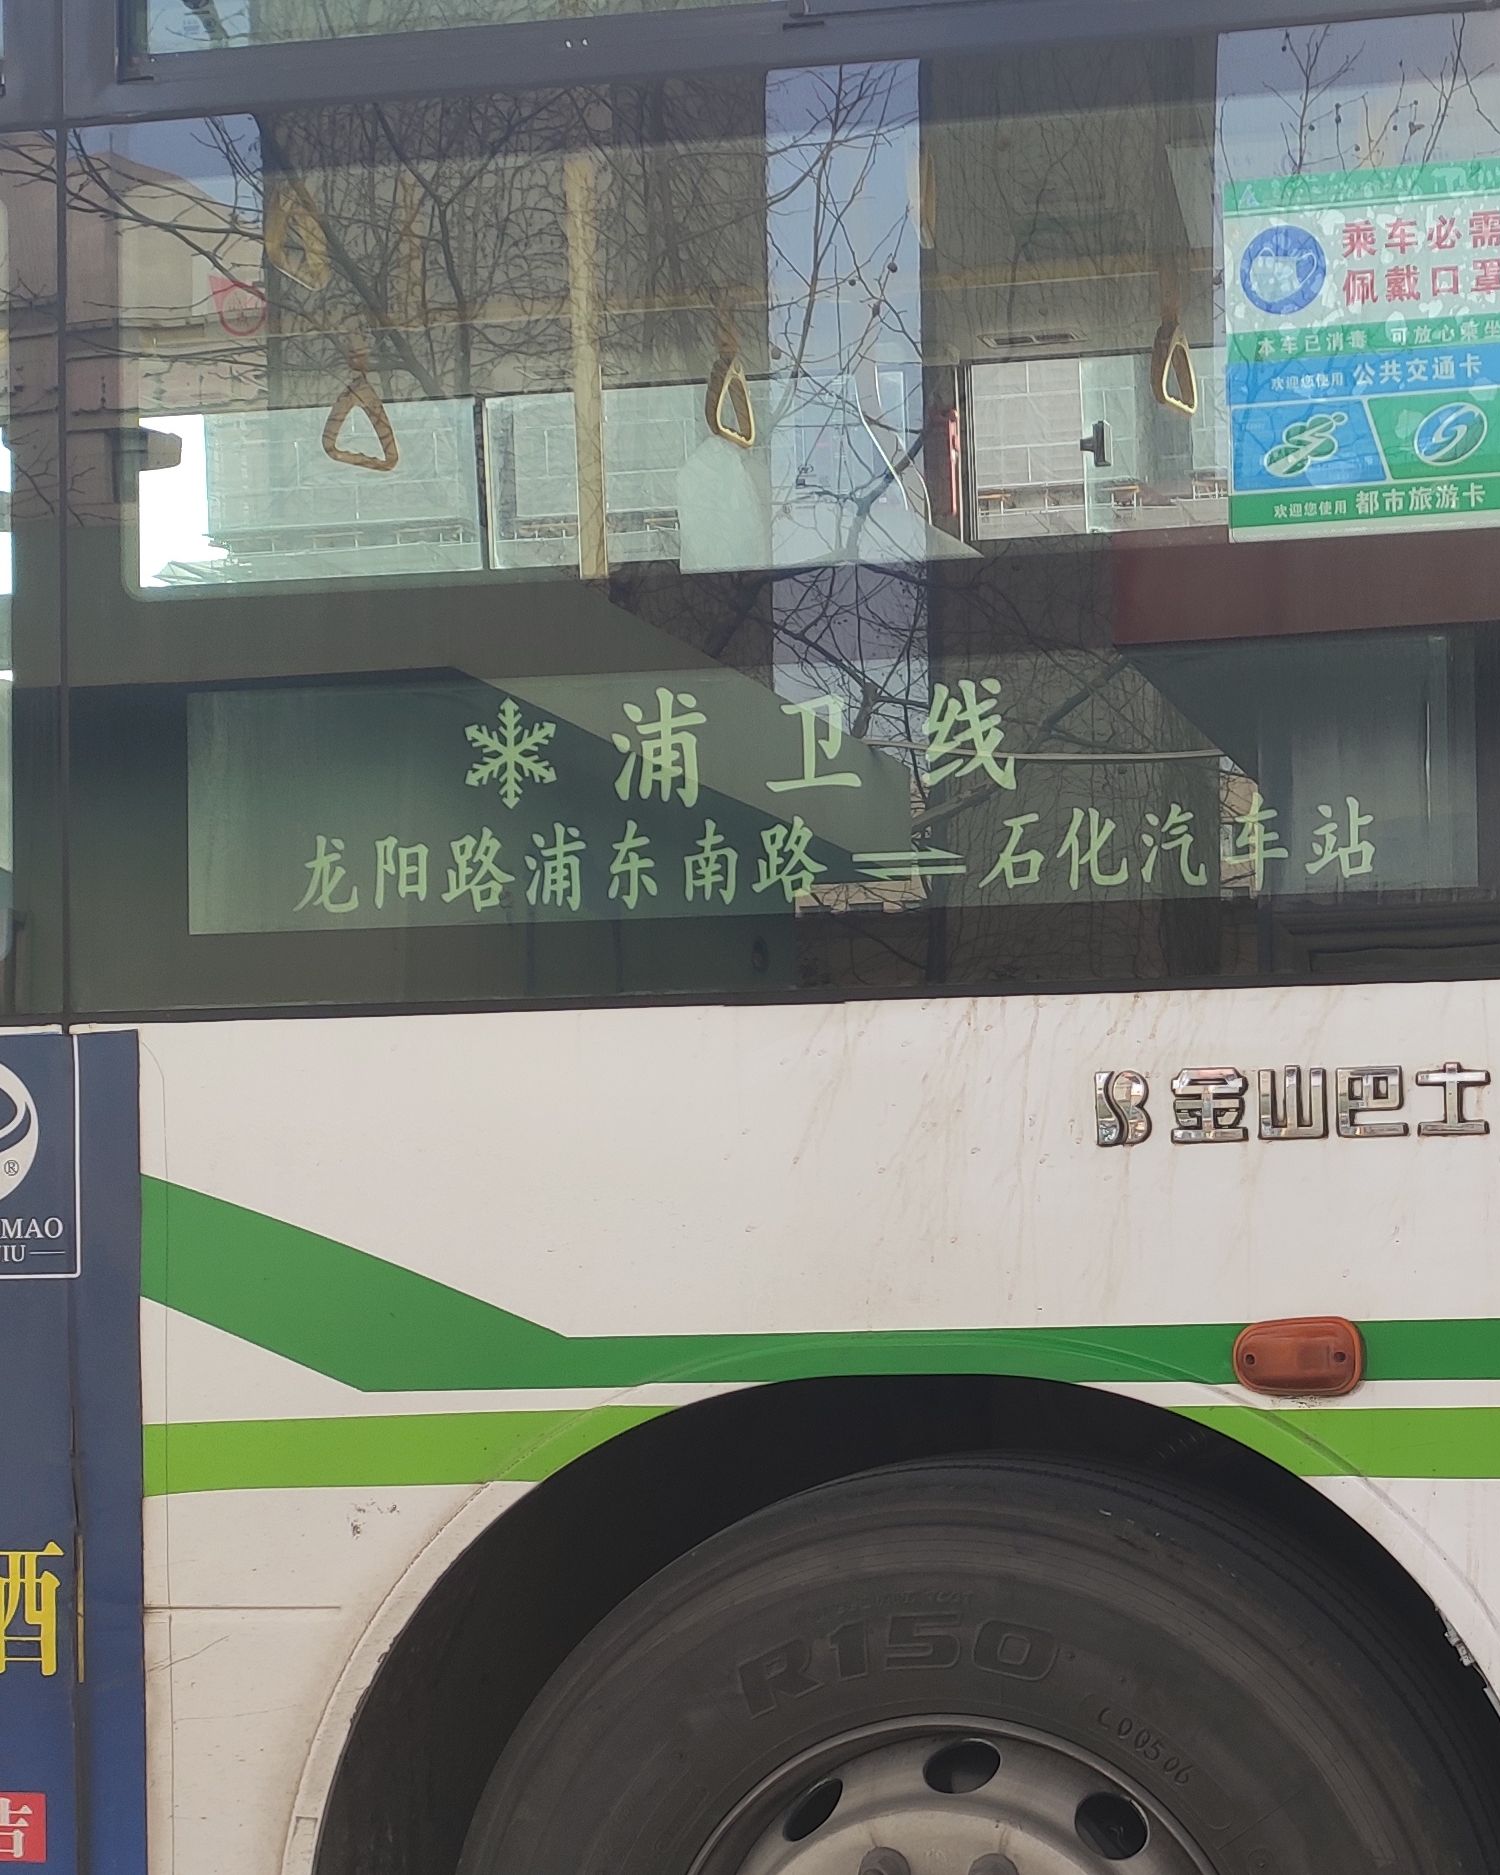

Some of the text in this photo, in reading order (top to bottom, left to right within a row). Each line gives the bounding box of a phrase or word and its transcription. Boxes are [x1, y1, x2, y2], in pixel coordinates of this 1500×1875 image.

[1258, 331, 1368, 356] 本车已消毒
[1271, 354, 1483, 390] 欢迎您使用 公共交通卡
[1273, 483, 1485, 519] 欢迎您使用 都市旅游卡
[611, 679, 1017, 807] 浦卫线
[293, 792, 1376, 913] 龙阳路浦东南路 石化汽车站
[1170, 1061, 1491, 1144] 金山巴士
[736, 1612, 1062, 1719] R150
